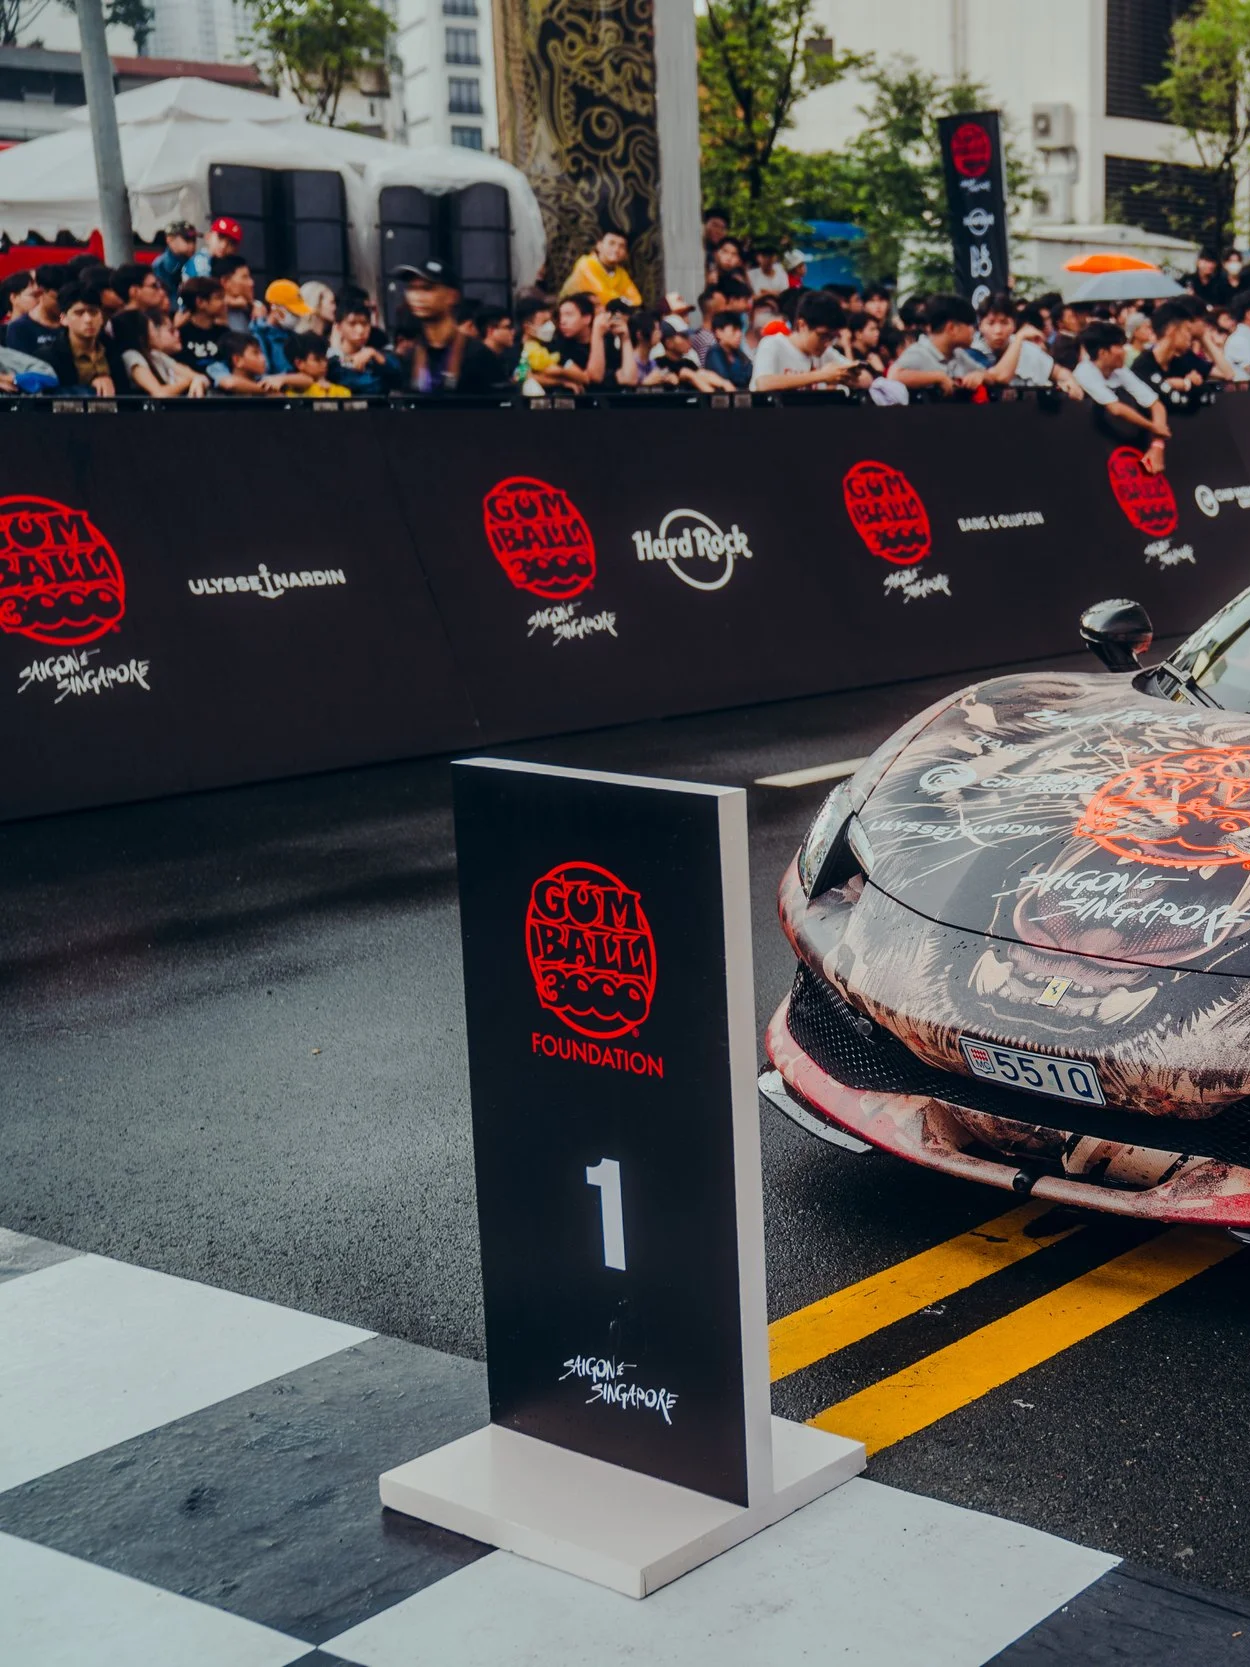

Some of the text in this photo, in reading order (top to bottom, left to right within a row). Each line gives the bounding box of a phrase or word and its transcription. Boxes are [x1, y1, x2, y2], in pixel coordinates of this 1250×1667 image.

[632, 524, 753, 562] Hard Rock
[188, 569, 347, 595] ULYSSE NARDIN
[54, 659, 150, 704] SINGAPORE
[869, 820, 950, 836] ULYSSE
[532, 1032, 663, 1078] FOUNDATION
[975, 1060, 992, 1070] MC
[586, 1158, 626, 1271] 1
[585, 1380, 679, 1425] SINGAPORE
